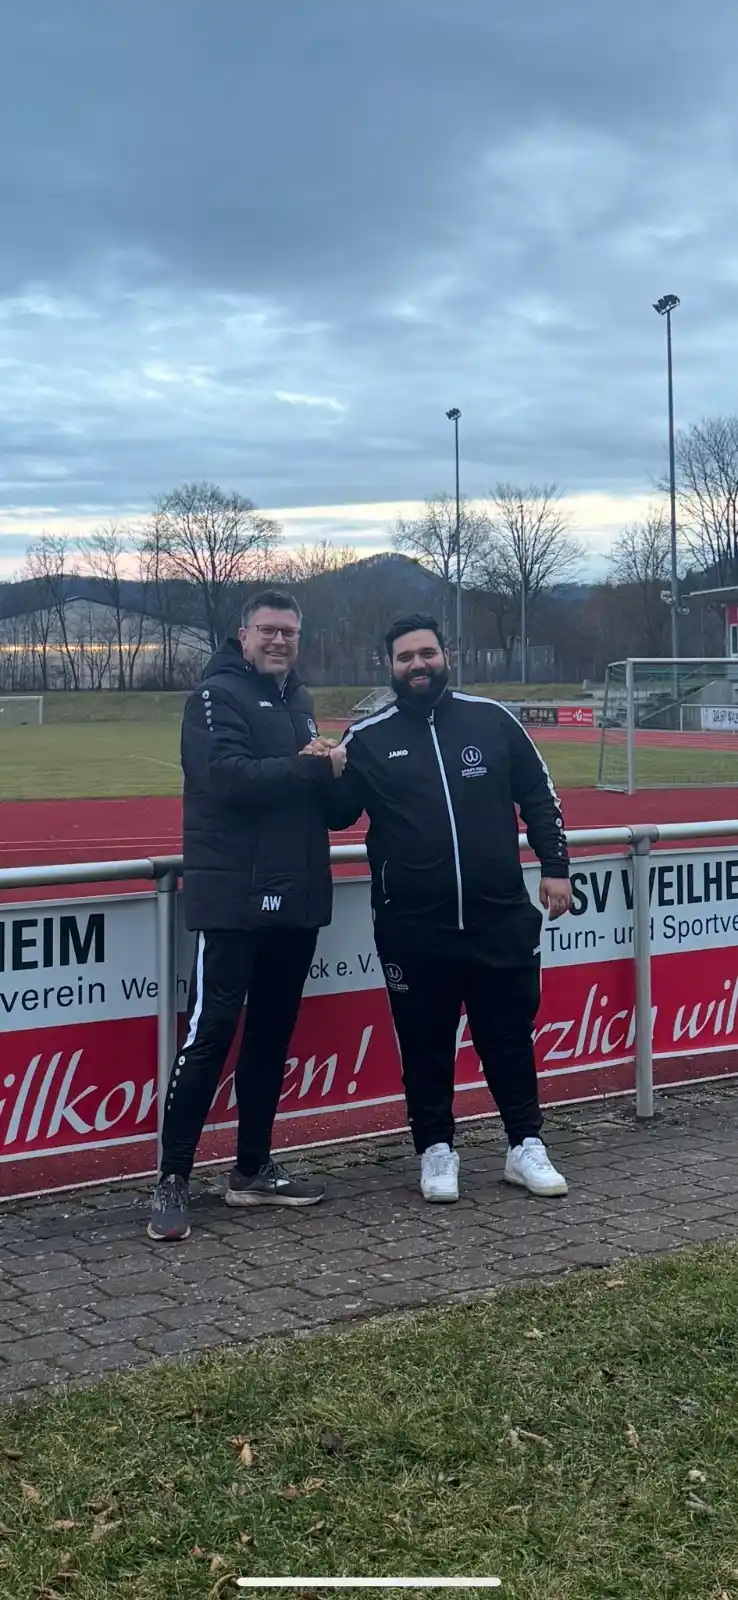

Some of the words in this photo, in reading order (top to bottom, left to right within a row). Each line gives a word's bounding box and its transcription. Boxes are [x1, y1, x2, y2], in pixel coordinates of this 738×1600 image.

[261, 895, 282, 911] AW
[569, 871, 613, 916] SV
[0, 913, 105, 972] EIM
[545, 927, 605, 951] Turn-
[0, 976, 105, 1013] verein
